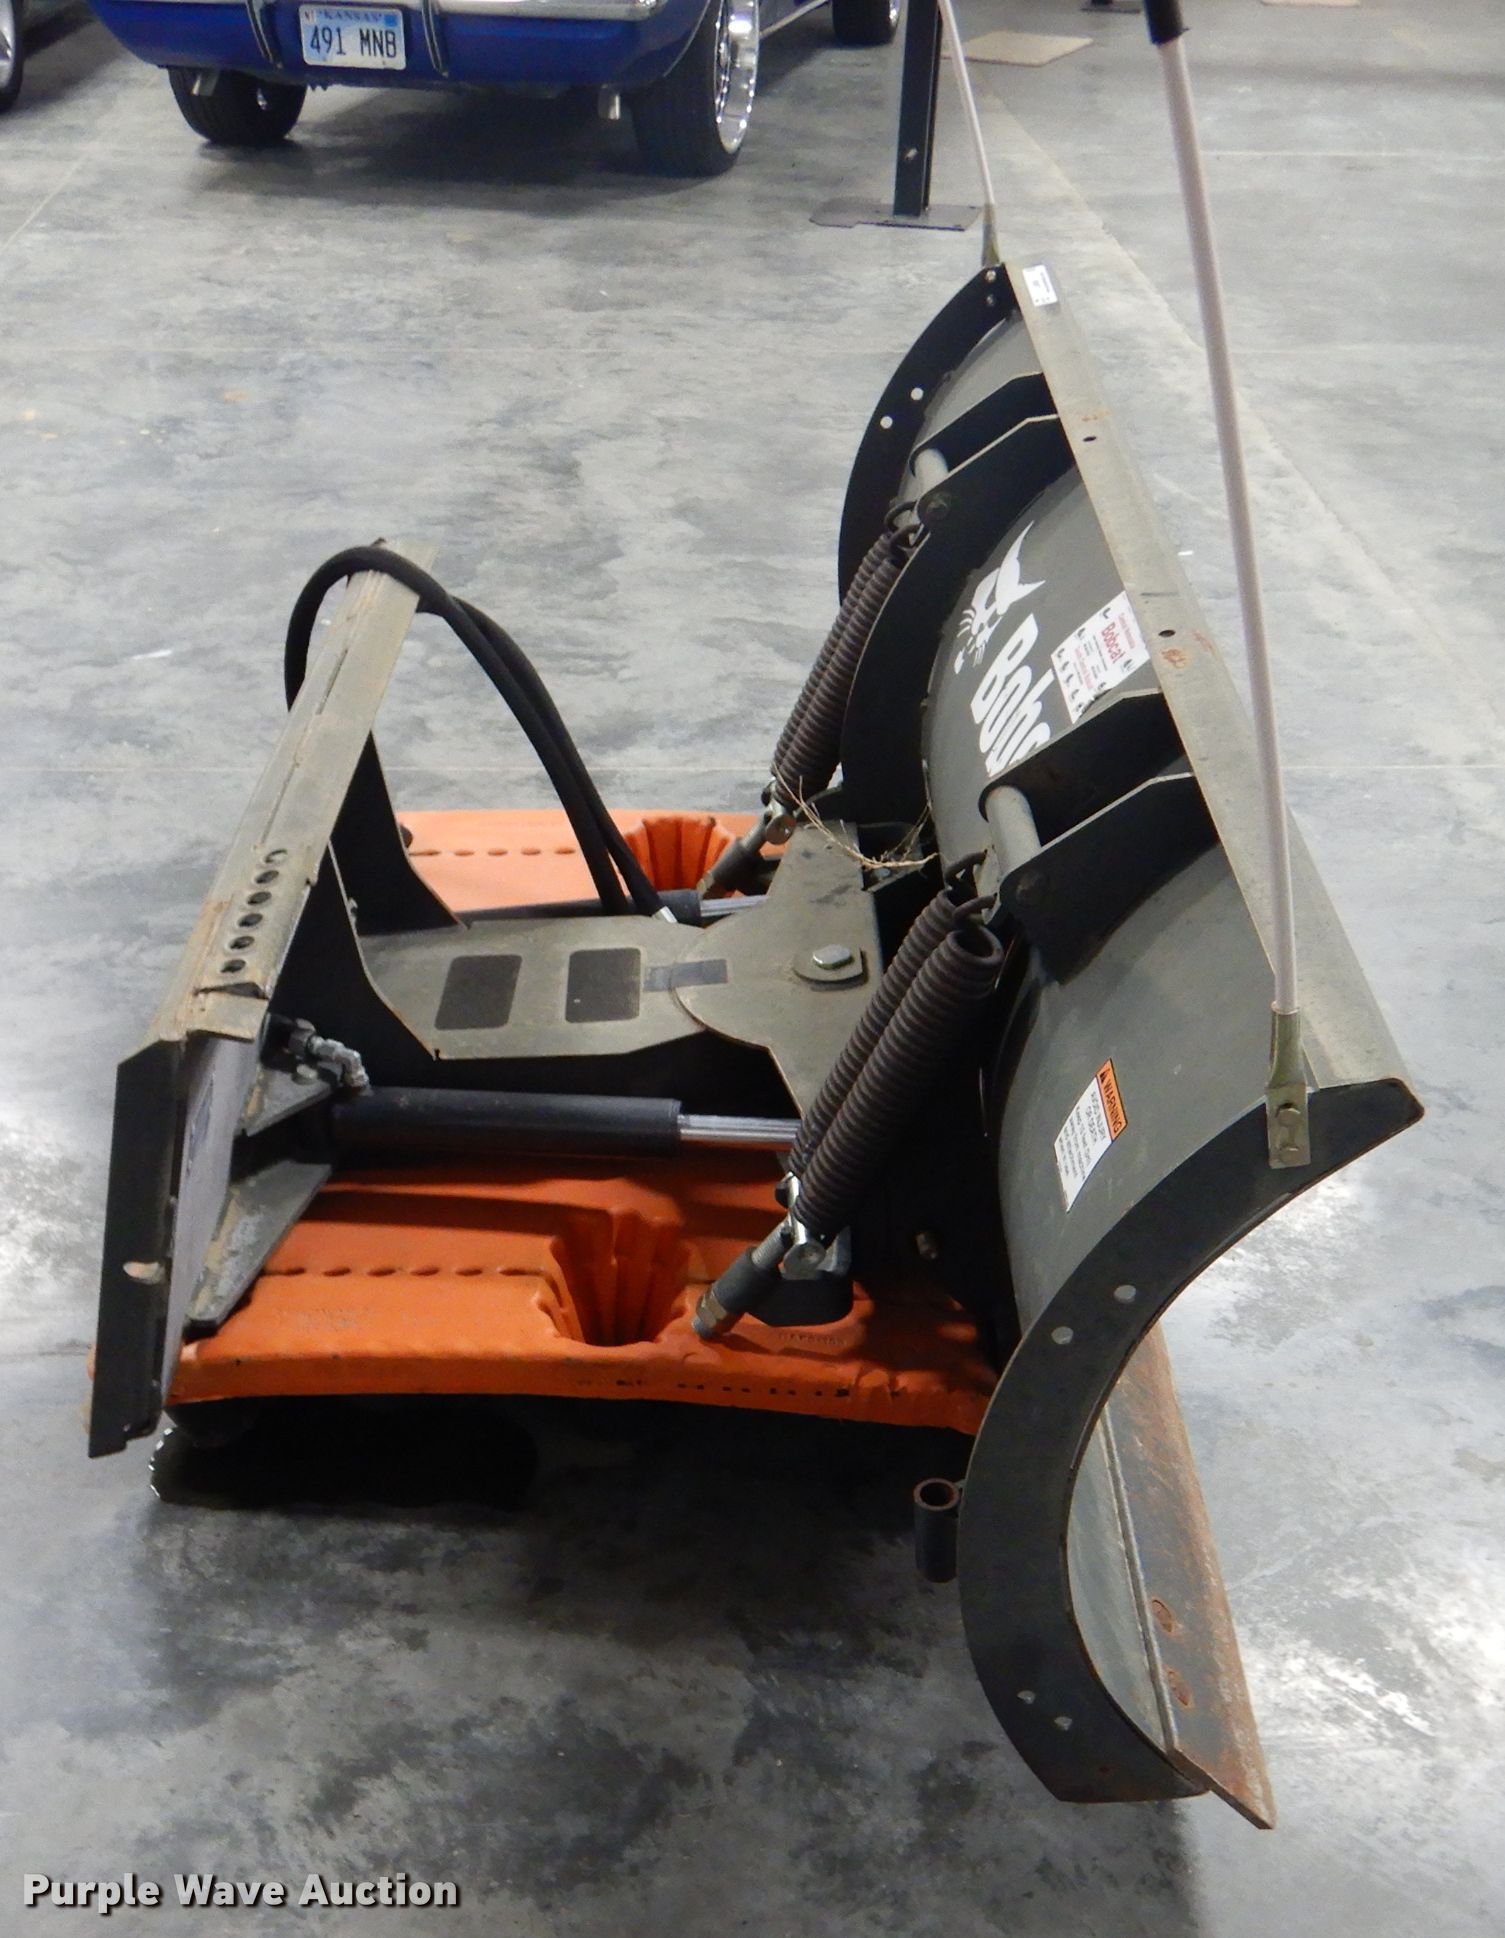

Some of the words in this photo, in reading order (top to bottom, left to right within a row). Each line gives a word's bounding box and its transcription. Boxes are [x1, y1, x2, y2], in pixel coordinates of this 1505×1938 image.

[310, 25, 346, 55] 491
[359, 28, 397, 58] MNB
[1101, 621, 1126, 664] Bobcat
[1103, 1080, 1122, 1134] WARNING
